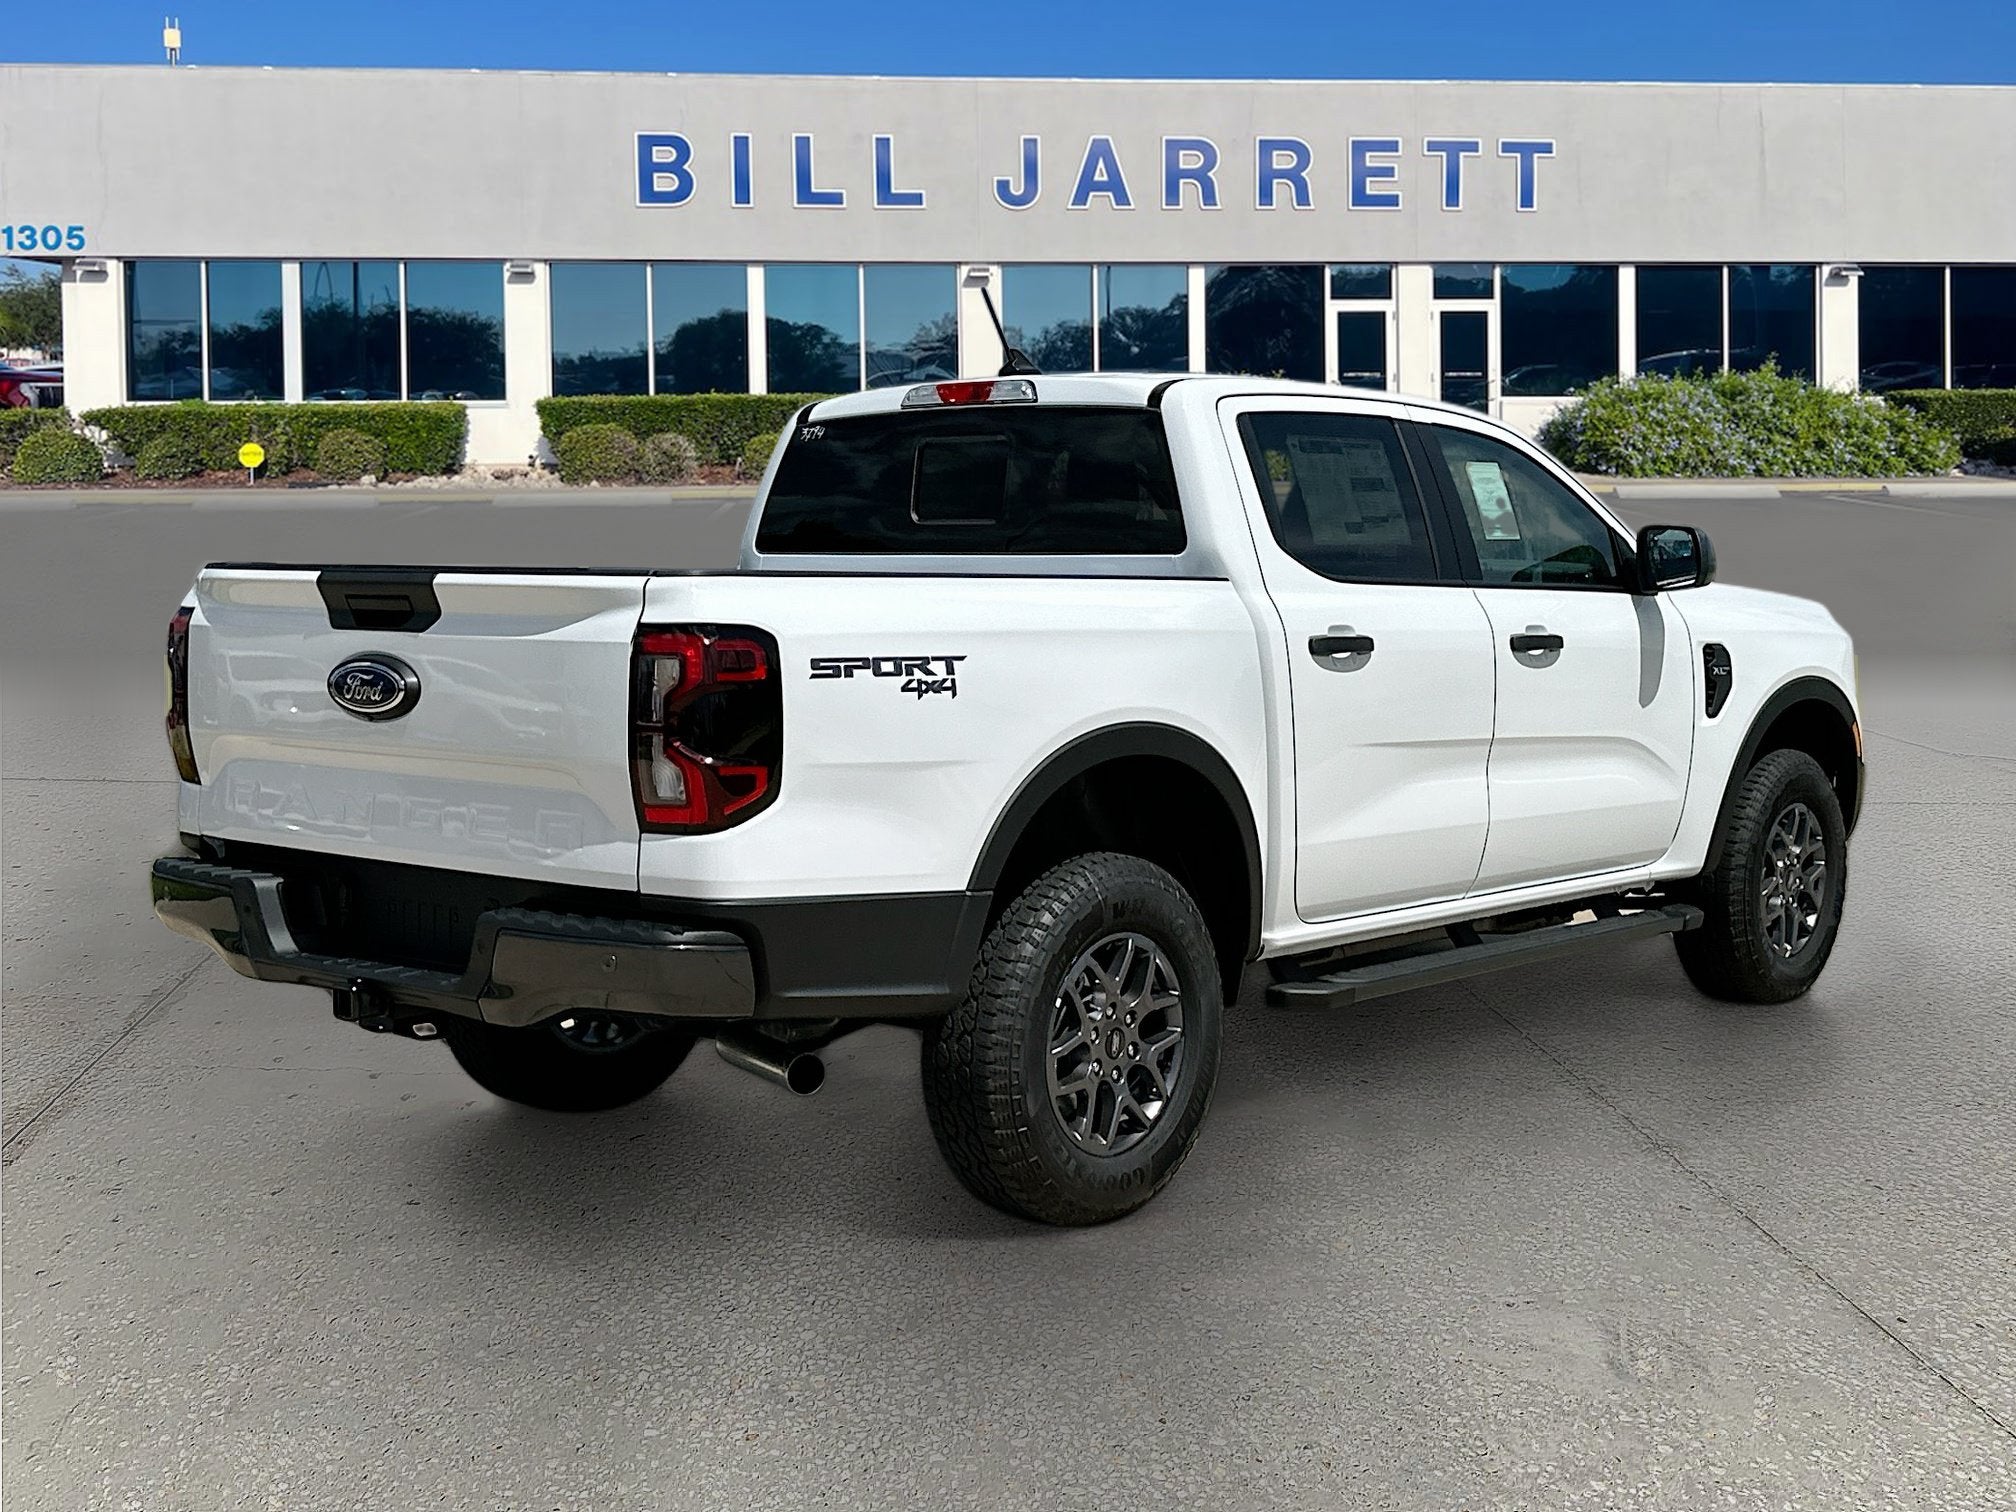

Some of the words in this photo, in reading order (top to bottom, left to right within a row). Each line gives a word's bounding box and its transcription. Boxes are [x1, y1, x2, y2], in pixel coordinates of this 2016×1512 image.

[634, 132, 926, 209] BILL
[993, 135, 1555, 211] JARRETT
[1, 224, 86, 251] 1305
[808, 655, 968, 680] SPORT
[343, 672, 384, 701] Ford
[900, 677, 958, 701] 4x4
